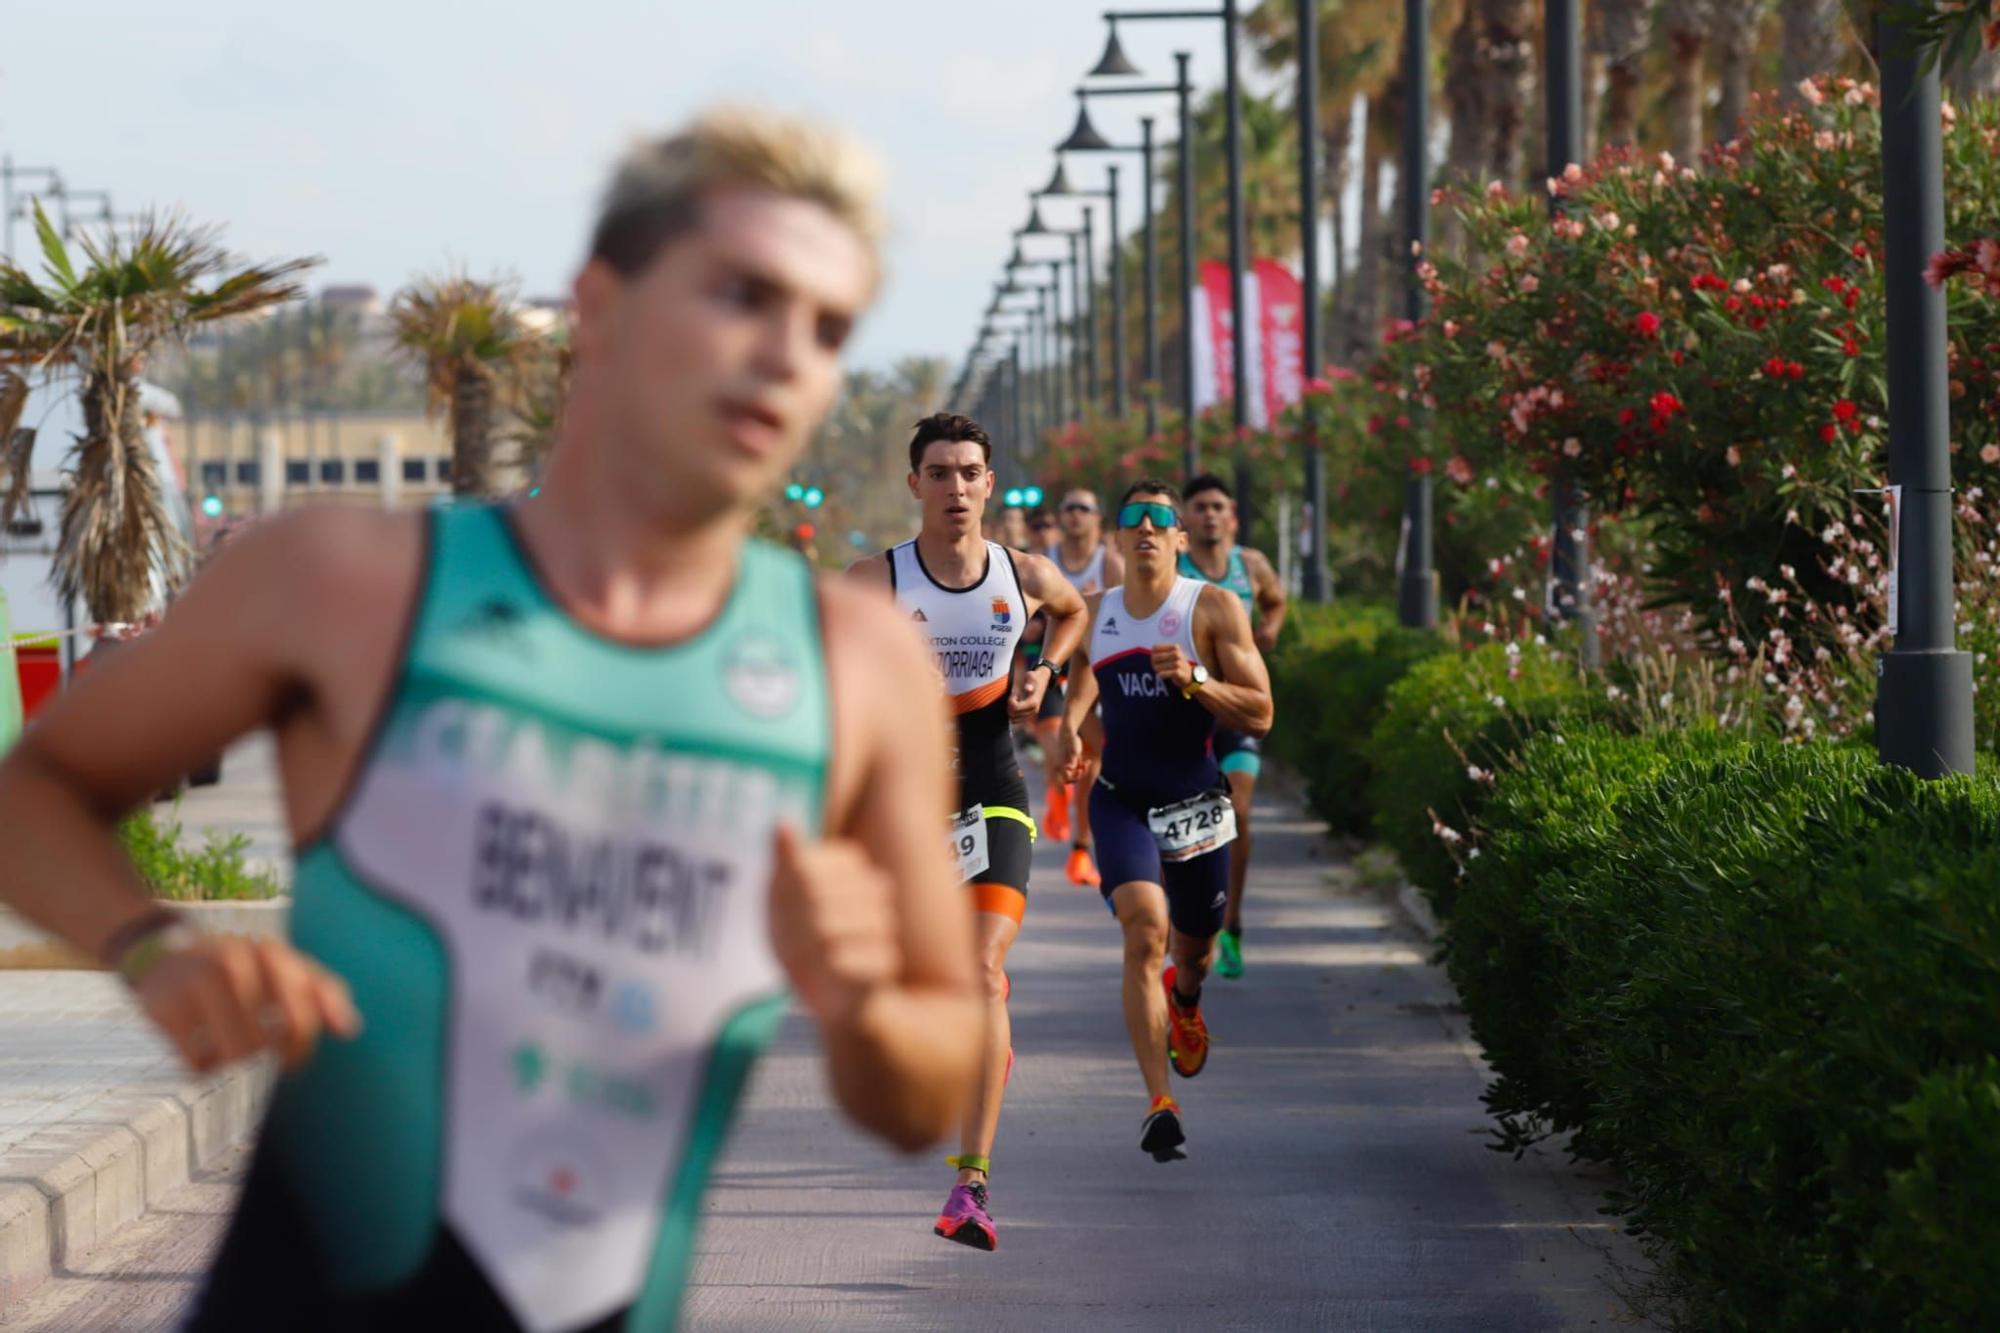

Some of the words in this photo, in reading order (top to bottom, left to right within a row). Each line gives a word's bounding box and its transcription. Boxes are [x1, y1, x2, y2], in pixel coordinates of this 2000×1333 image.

[960, 636, 1007, 647] COLLEGE
[1117, 672, 1169, 697] VACA
[1164, 805, 1223, 840] 4728
